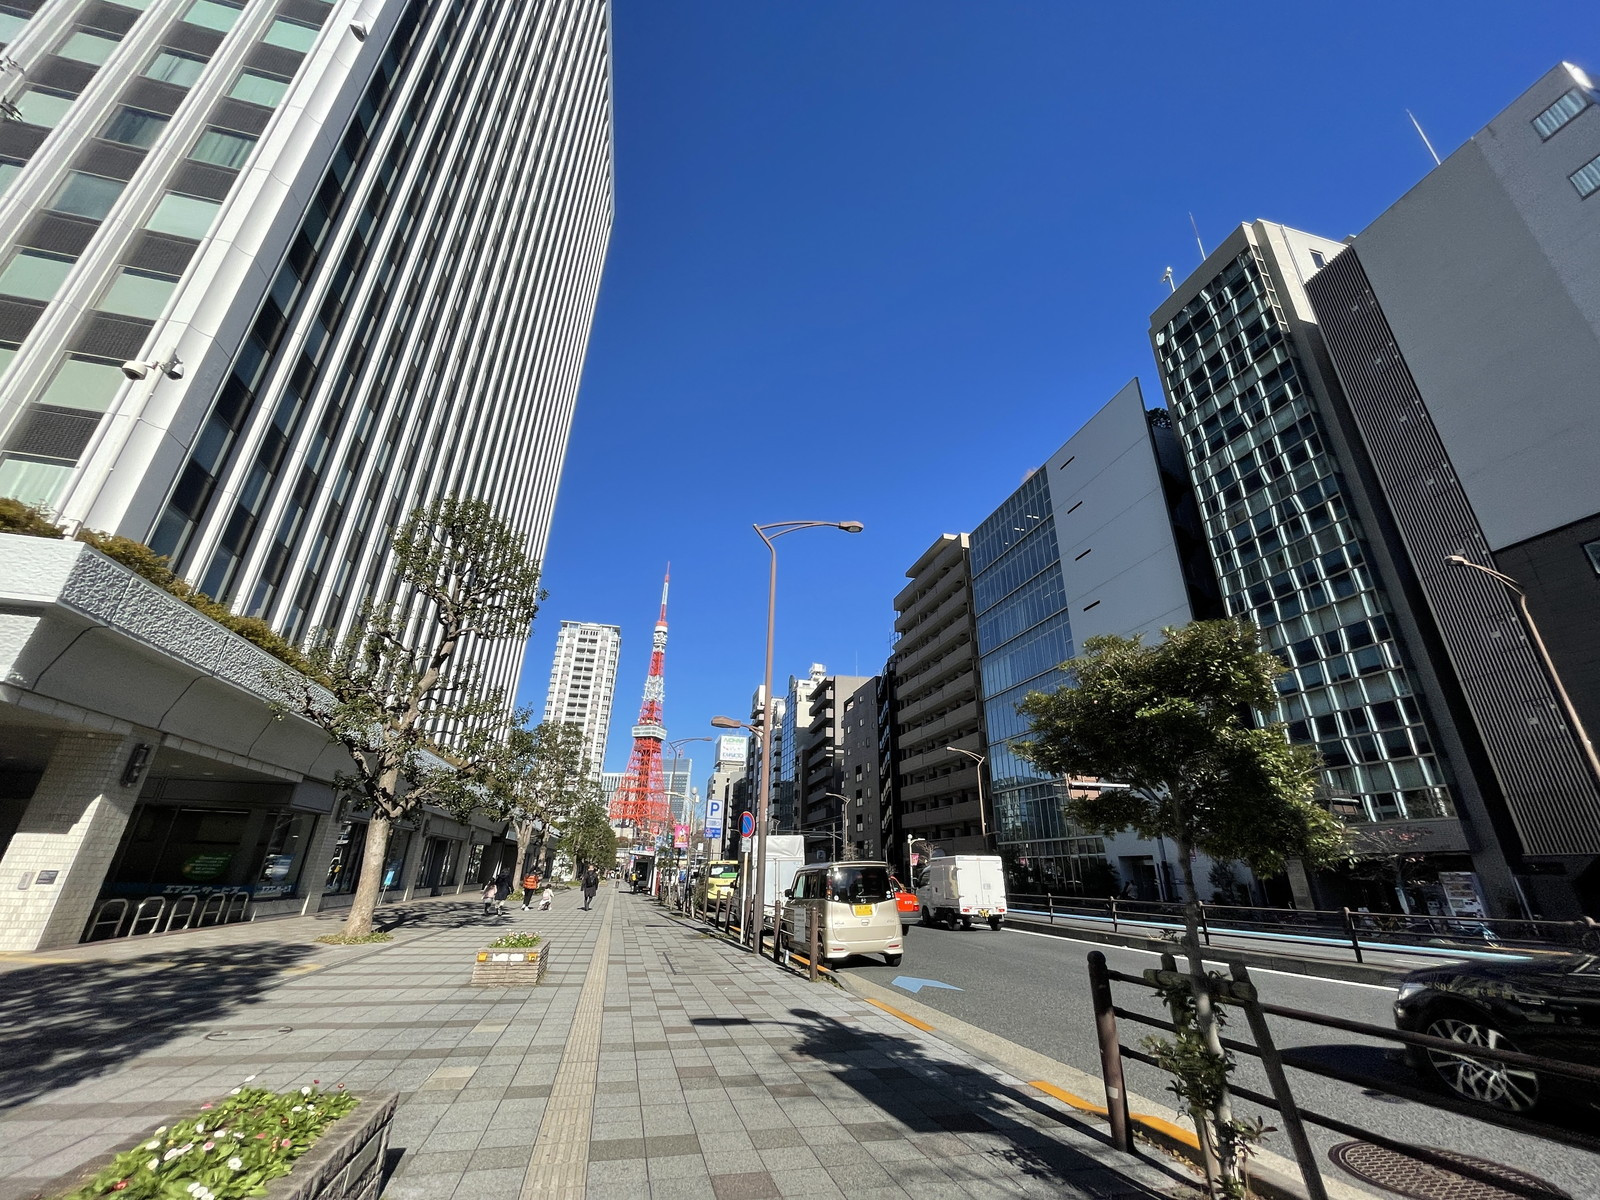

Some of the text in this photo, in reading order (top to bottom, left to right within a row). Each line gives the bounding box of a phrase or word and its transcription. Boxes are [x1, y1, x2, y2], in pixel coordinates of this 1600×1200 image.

[710, 802, 720, 816] P
[162, 885, 241, 894] エアコンサービス
